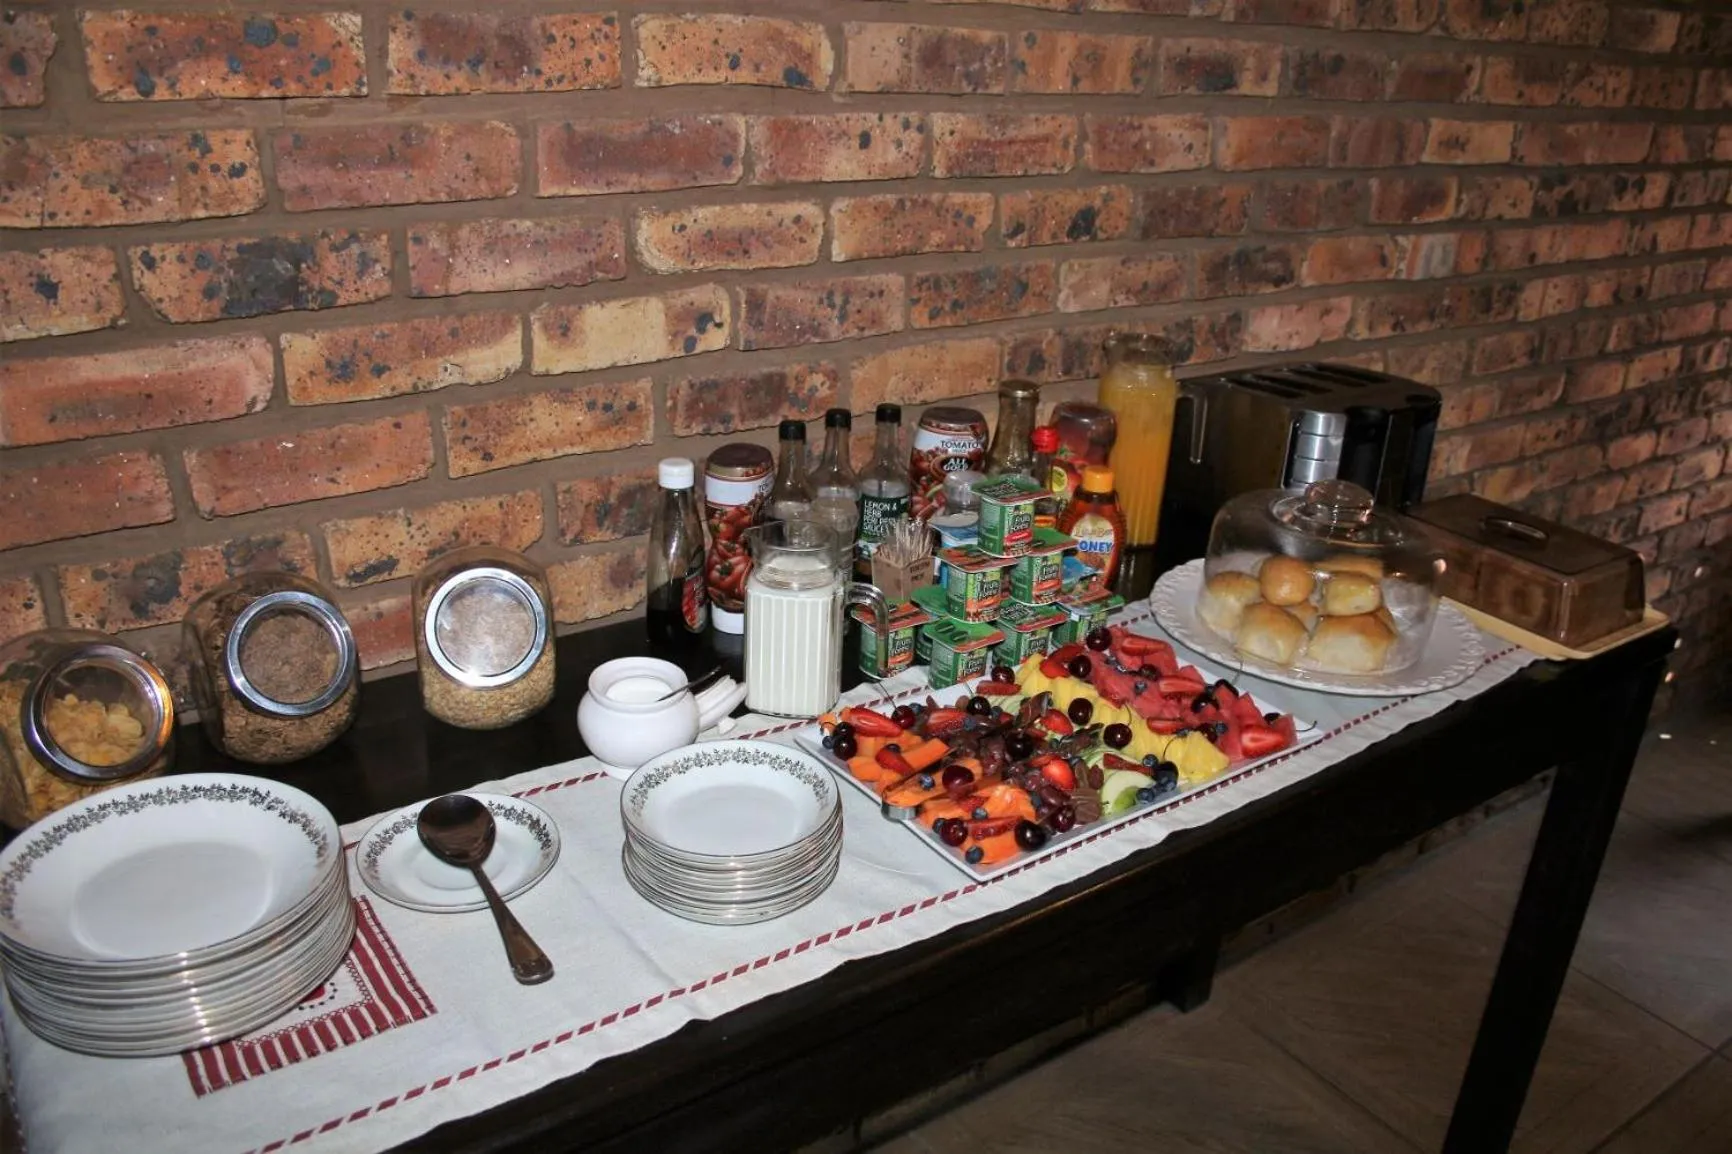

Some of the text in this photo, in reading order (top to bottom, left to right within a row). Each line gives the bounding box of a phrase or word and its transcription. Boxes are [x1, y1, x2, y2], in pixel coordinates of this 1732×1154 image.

[940, 440, 979, 449] TOMATO
[943, 463, 969, 471] GOLD
[948, 458, 966, 467] ALL
[864, 500, 897, 511] LEMON &
[864, 508, 881, 518] HERB
[1079, 540, 1113, 552] ONEY
